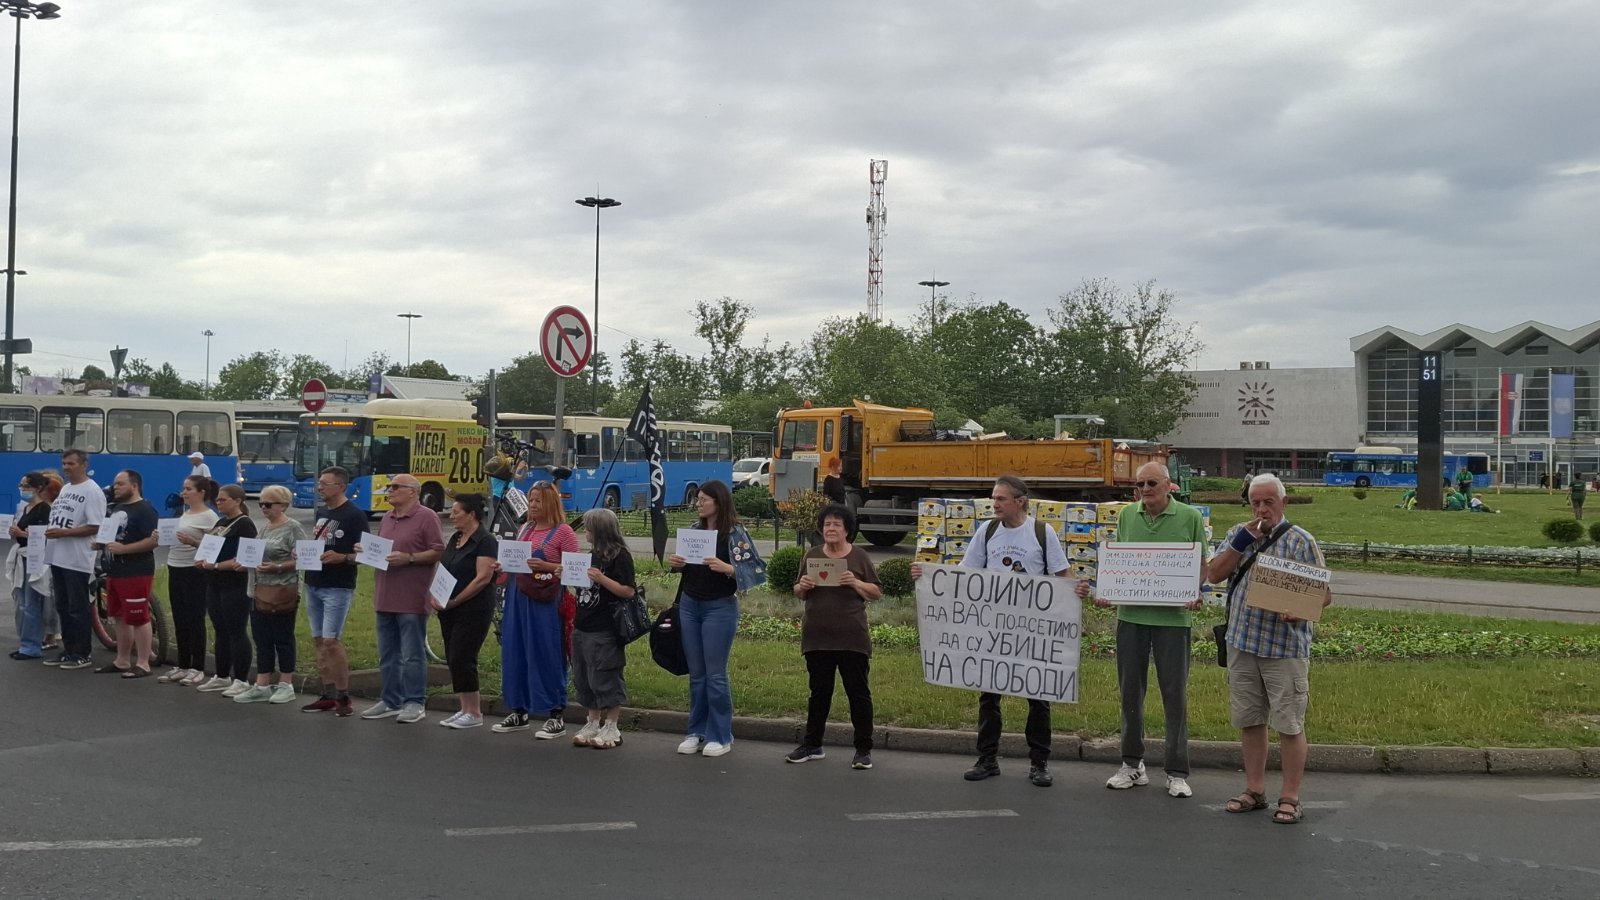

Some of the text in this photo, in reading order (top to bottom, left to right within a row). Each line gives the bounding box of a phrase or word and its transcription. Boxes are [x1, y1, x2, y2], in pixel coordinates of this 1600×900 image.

[1424, 356, 1436, 367] 11
[1423, 369, 1436, 380] 51
[414, 432, 446, 456] MEGA
[412, 458, 446, 473] JACKPOT
[449, 447, 488, 484] 28.0
[1105, 559, 1192, 568] ПОСЛЕДЊА СТАНИЦА
[1292, 563, 1327, 580] ZASTAREVA
[932, 569, 1054, 611] СТОЈИМО
[1133, 579, 1166, 587] СМЕМО
[1153, 590, 1196, 598] КРИВЦИМА
[925, 601, 1078, 639] ДА ВАС ПОДСЕТИМО
[939, 631, 1065, 667] ДА СУ УБИЦЕ
[924, 651, 1076, 701] НА СЛОБОДИ
